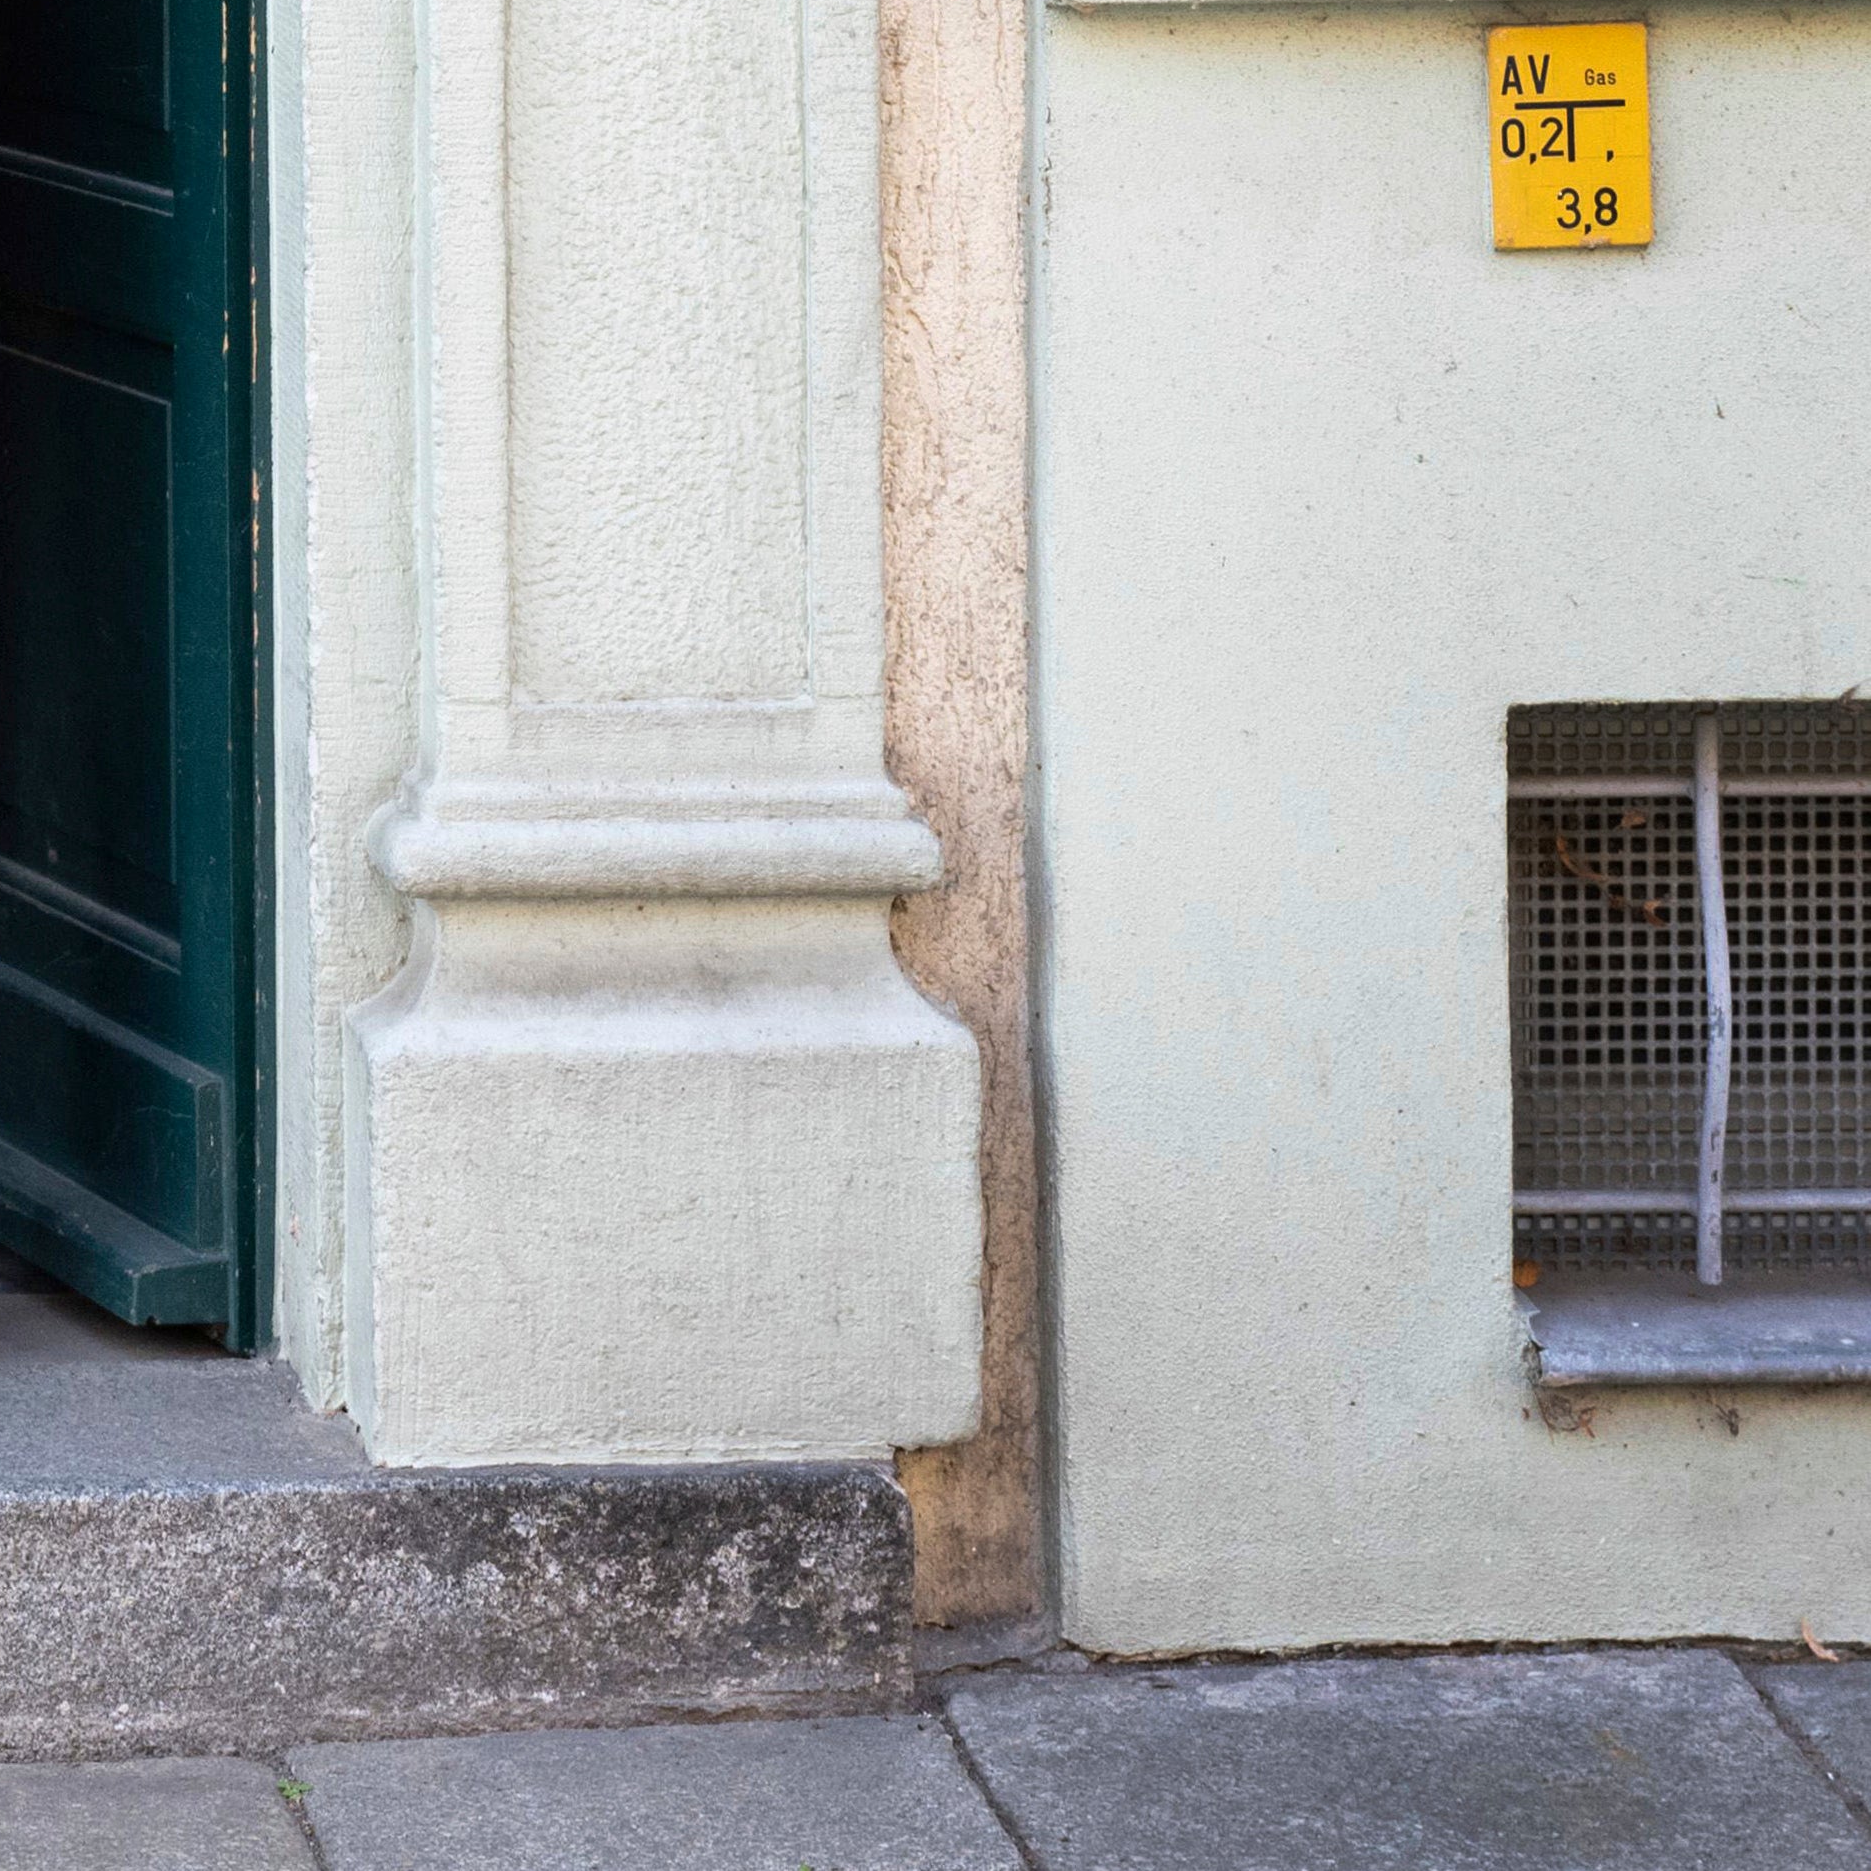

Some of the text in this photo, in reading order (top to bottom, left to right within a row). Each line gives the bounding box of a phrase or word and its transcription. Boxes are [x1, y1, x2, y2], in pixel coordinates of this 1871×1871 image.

[1501, 54, 1617, 96] AV Gas
[1501, 117, 1565, 165] 0,2
[1557, 187, 1618, 235] 3,8
